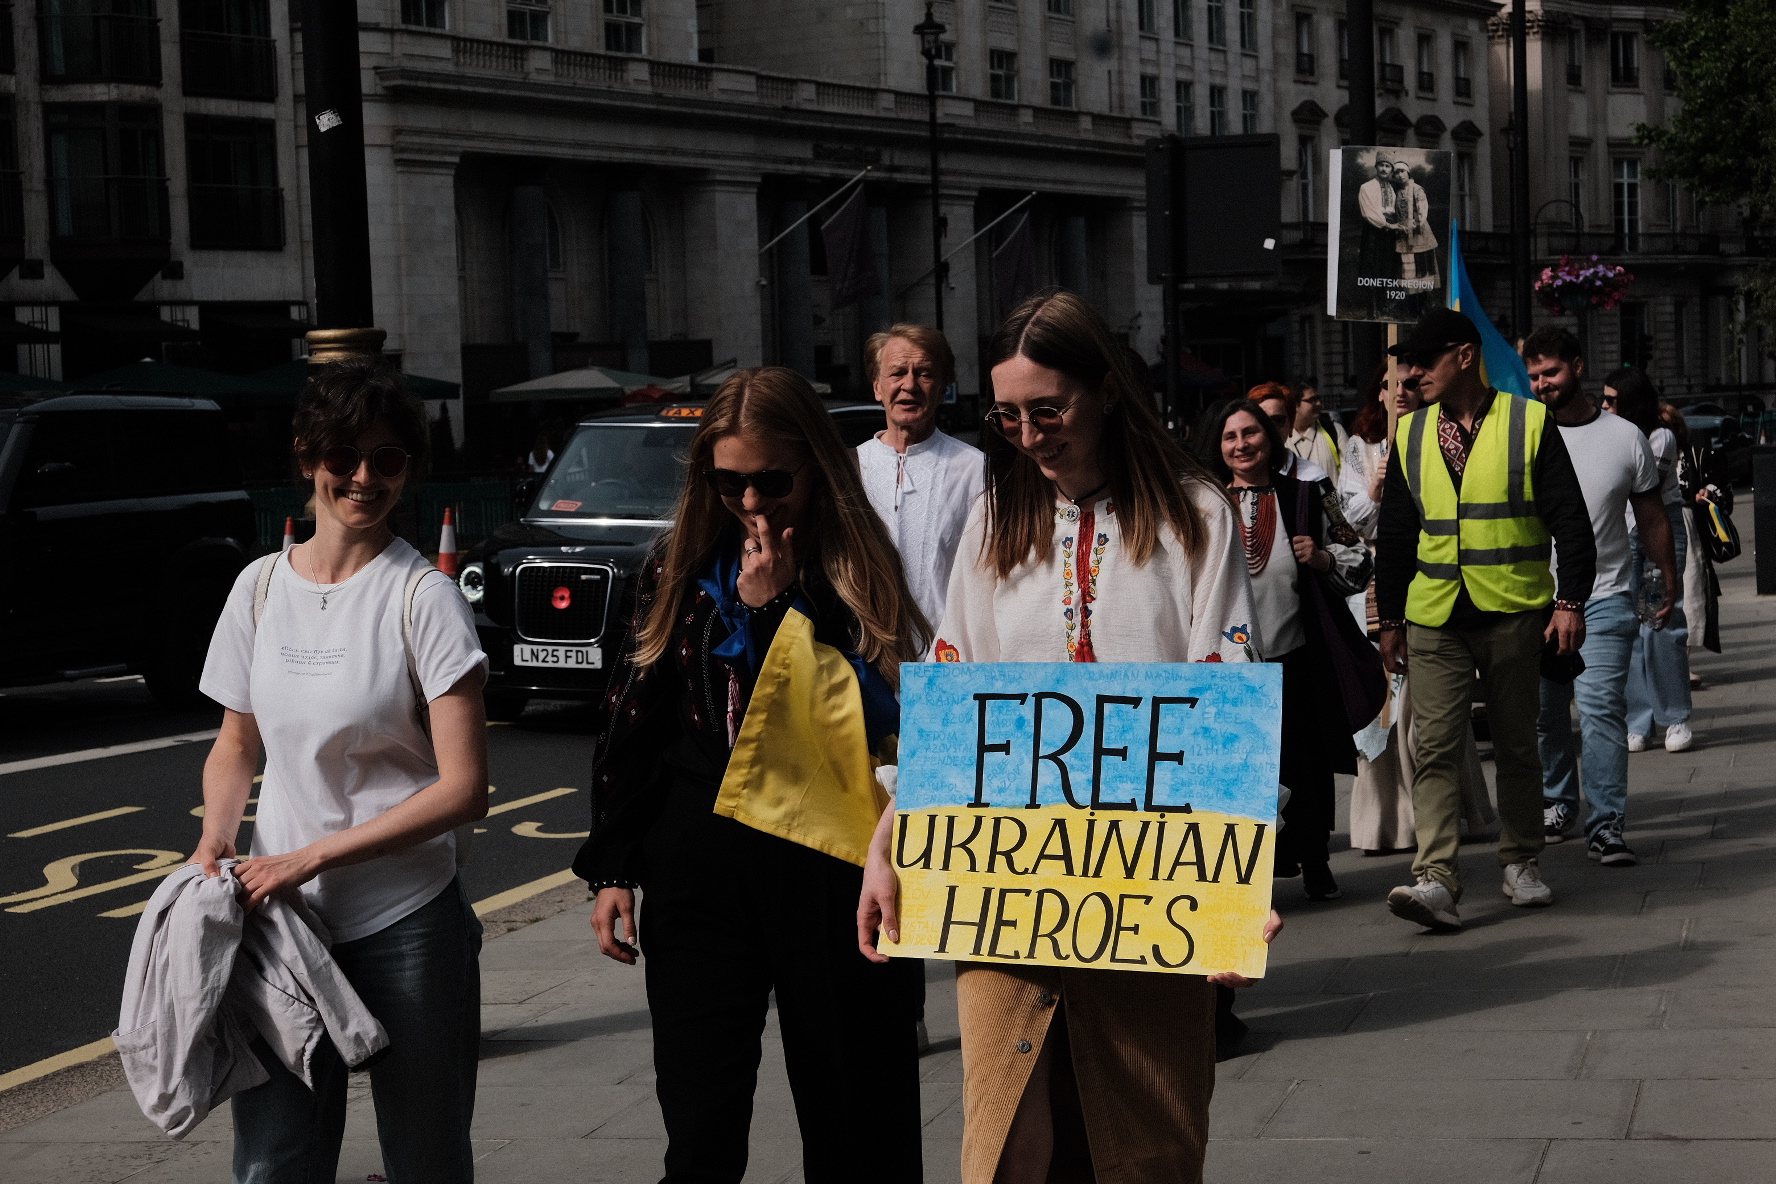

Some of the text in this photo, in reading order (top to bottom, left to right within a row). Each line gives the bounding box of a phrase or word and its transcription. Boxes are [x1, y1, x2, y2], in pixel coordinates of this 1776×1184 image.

[1357, 277, 1435, 290] DONETSK REGION
[1386, 291, 1406, 301] 1920
[520, 647, 596, 665] LN25 FDL
[967, 691, 1200, 815] FREE
[895, 811, 1269, 885] UKRAINIAN
[934, 885, 1199, 969] HEROES
